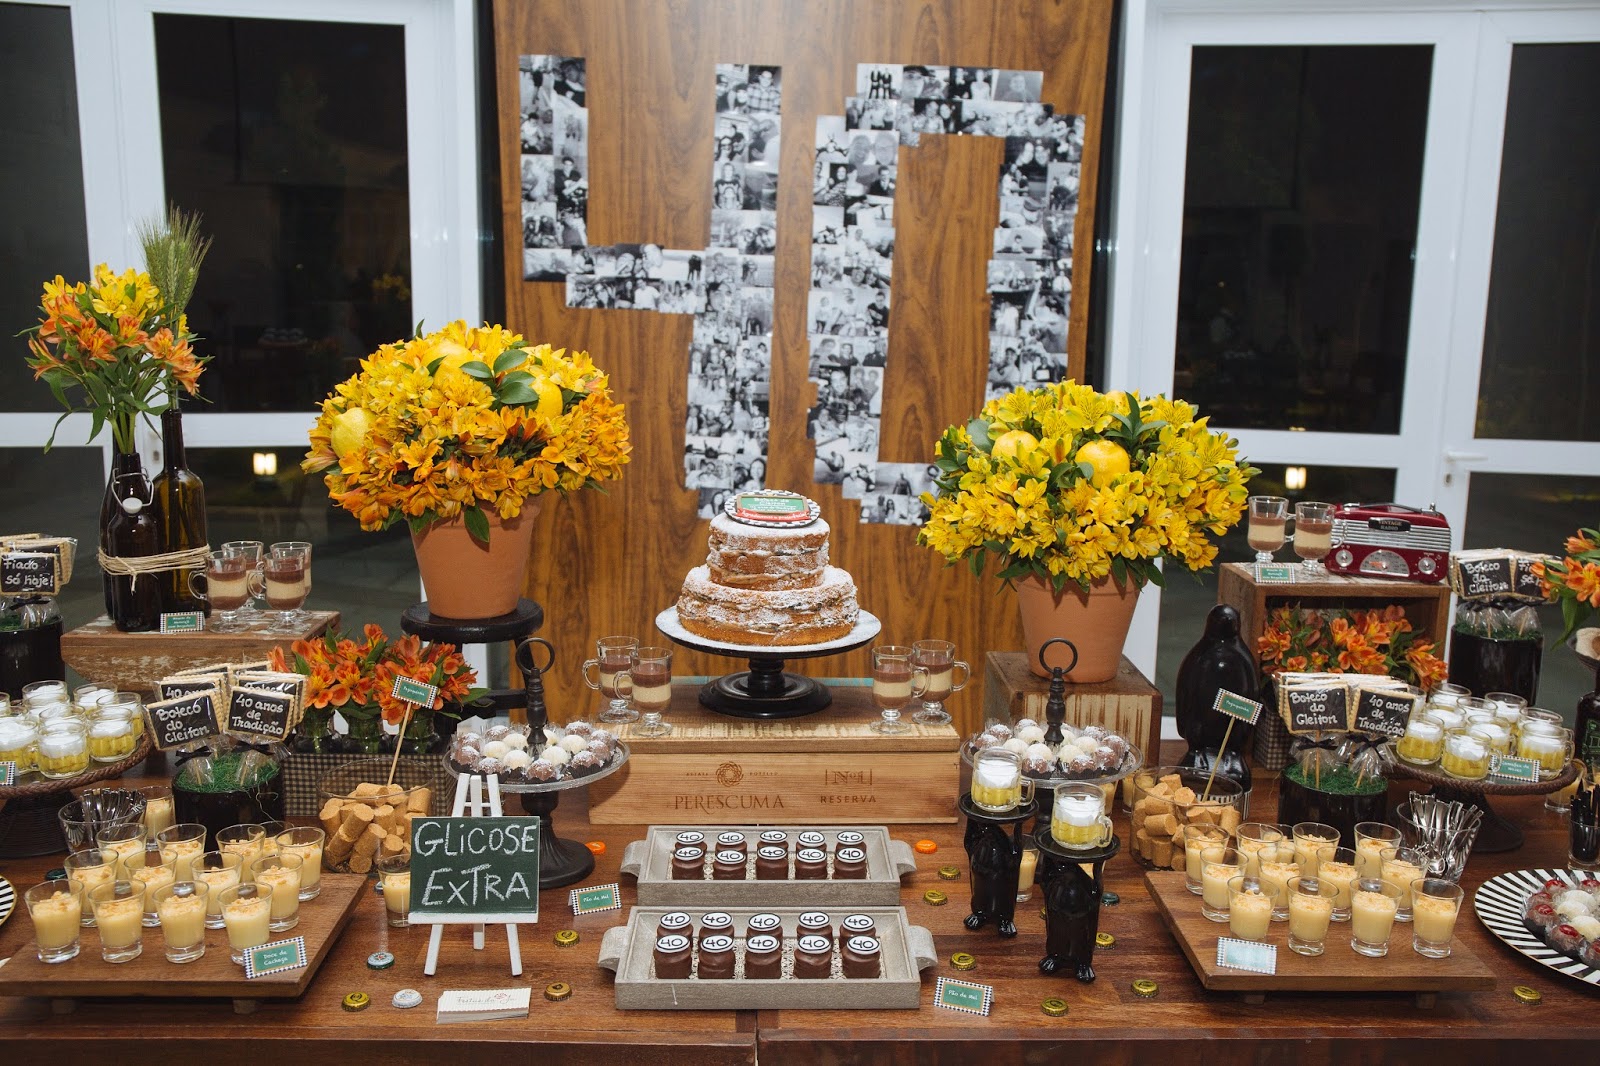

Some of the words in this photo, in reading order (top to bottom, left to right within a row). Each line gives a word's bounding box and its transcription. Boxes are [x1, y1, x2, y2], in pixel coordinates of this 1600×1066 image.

[4, 558, 39, 570] Fiado
[1465, 561, 1500, 574] Boteco
[5, 572, 21, 585] Só
[24, 573, 54, 588] hoje!
[1290, 691, 1328, 703] Boteco
[236, 694, 252, 708] 40
[255, 702, 284, 713] anos
[1310, 703, 1326, 713] do
[1369, 695, 1384, 708] 40
[1385, 701, 1410, 713] anos
[156, 704, 202, 722] Boteco
[246, 710, 262, 720] de
[1371, 709, 1385, 719] de
[167, 720, 183, 731] do
[232, 716, 284, 736] Tradição
[1358, 716, 1406, 737] Tradição
[165, 725, 210, 743] Cleiton
[820, 794, 877, 804] RESERVA
[674, 794, 785, 815] PERESCUMA
[680, 833, 699, 841] 40
[803, 833, 820, 842] 40
[841, 833, 860, 841] 40
[678, 848, 699, 856] 40
[721, 852, 741, 860] 40
[761, 848, 783, 856] 40
[802, 851, 822, 859] 40
[841, 850, 862, 858] 40
[665, 915, 686, 924] 40
[704, 915, 726, 923] 40
[754, 917, 775, 926] 40
[803, 915, 826, 923] 40
[848, 918, 869, 926] 40
[660, 938, 683, 947] 40
[705, 938, 728, 947] 40
[751, 938, 774, 947] 40
[803, 939, 826, 947] 40
[852, 940, 874, 949] 40
